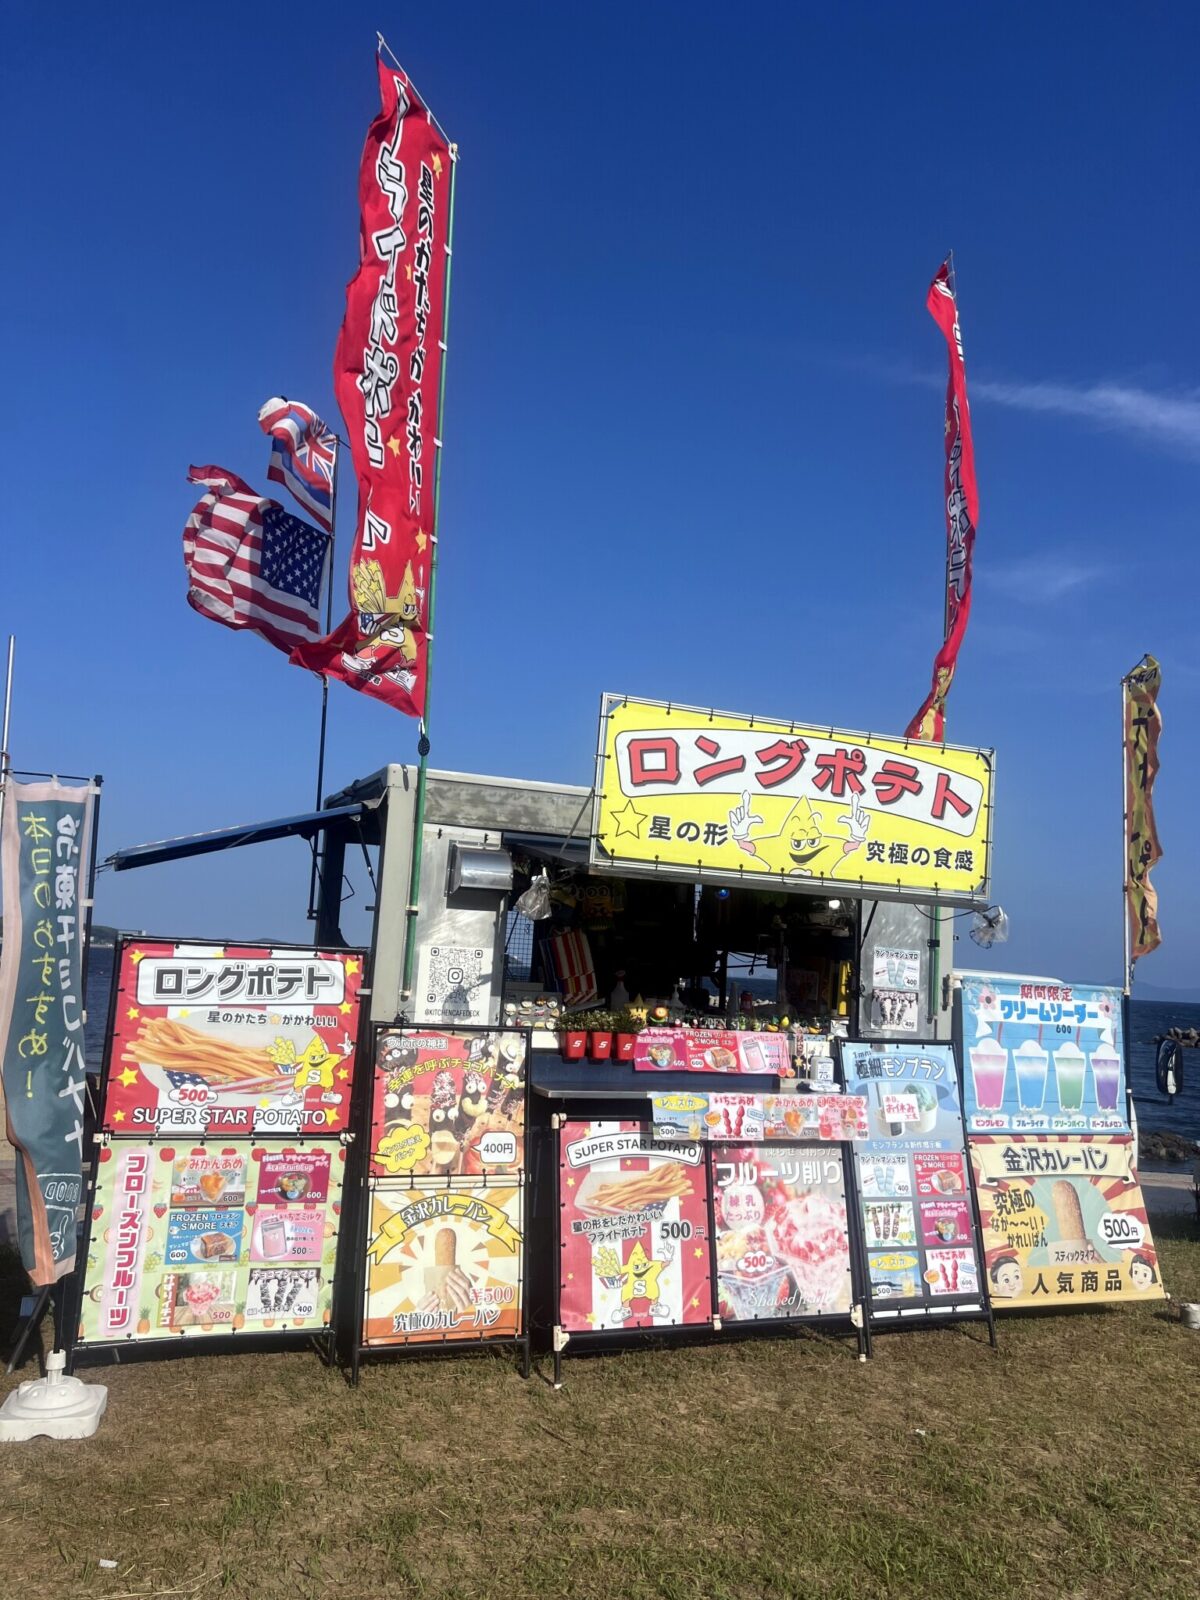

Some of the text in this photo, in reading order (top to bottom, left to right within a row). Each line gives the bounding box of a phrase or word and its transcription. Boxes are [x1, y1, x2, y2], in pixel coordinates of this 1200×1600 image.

[627, 735, 973, 821] ロングポテト
[648, 816, 729, 847] 星の形
[866, 840, 974, 873] 究極の食感
[154, 963, 332, 999] ロングポテト
[1021, 984, 1072, 1001] 期間限定
[207, 1011, 338, 1027] 星のかたち がかわいい
[1000, 1000, 1098, 1024] クリームソーダー
[1056, 1024, 1072, 1034] 600
[855, 1058, 945, 1080] 極細モンブラン
[179, 1089, 208, 1102] 500
[132, 1107, 326, 1125] SUPER STAR POTATO
[483, 1143, 513, 1154] 400円
[575, 1139, 697, 1159] SUPER STAR POTATO
[190, 1158, 243, 1170] みかんあめ
[1002, 1146, 1108, 1172] 金沢カレーパン
[716, 1161, 841, 1186] フルーツ削り
[400, 1196, 493, 1226] 金沢カレーパン
[992, 1188, 1035, 1216] 究極の
[170, 1213, 209, 1222] FROZEN
[181, 1222, 217, 1231] S'MORE
[279, 1213, 321, 1222] いちごミルク
[660, 1221, 691, 1239] 500
[1104, 1219, 1138, 1238] 500円
[108, 1154, 148, 1329] フローズンフルーツ
[1007, 1231, 1049, 1249] かれいぱん
[291, 1247, 307, 1255] 500
[1055, 1250, 1095, 1262] スティックタイプ
[744, 1255, 766, 1268] 500
[1031, 1269, 1122, 1295] 人気商品
[212, 1311, 231, 1320] 500
[393, 1308, 501, 1332] 究極のカレーパン
